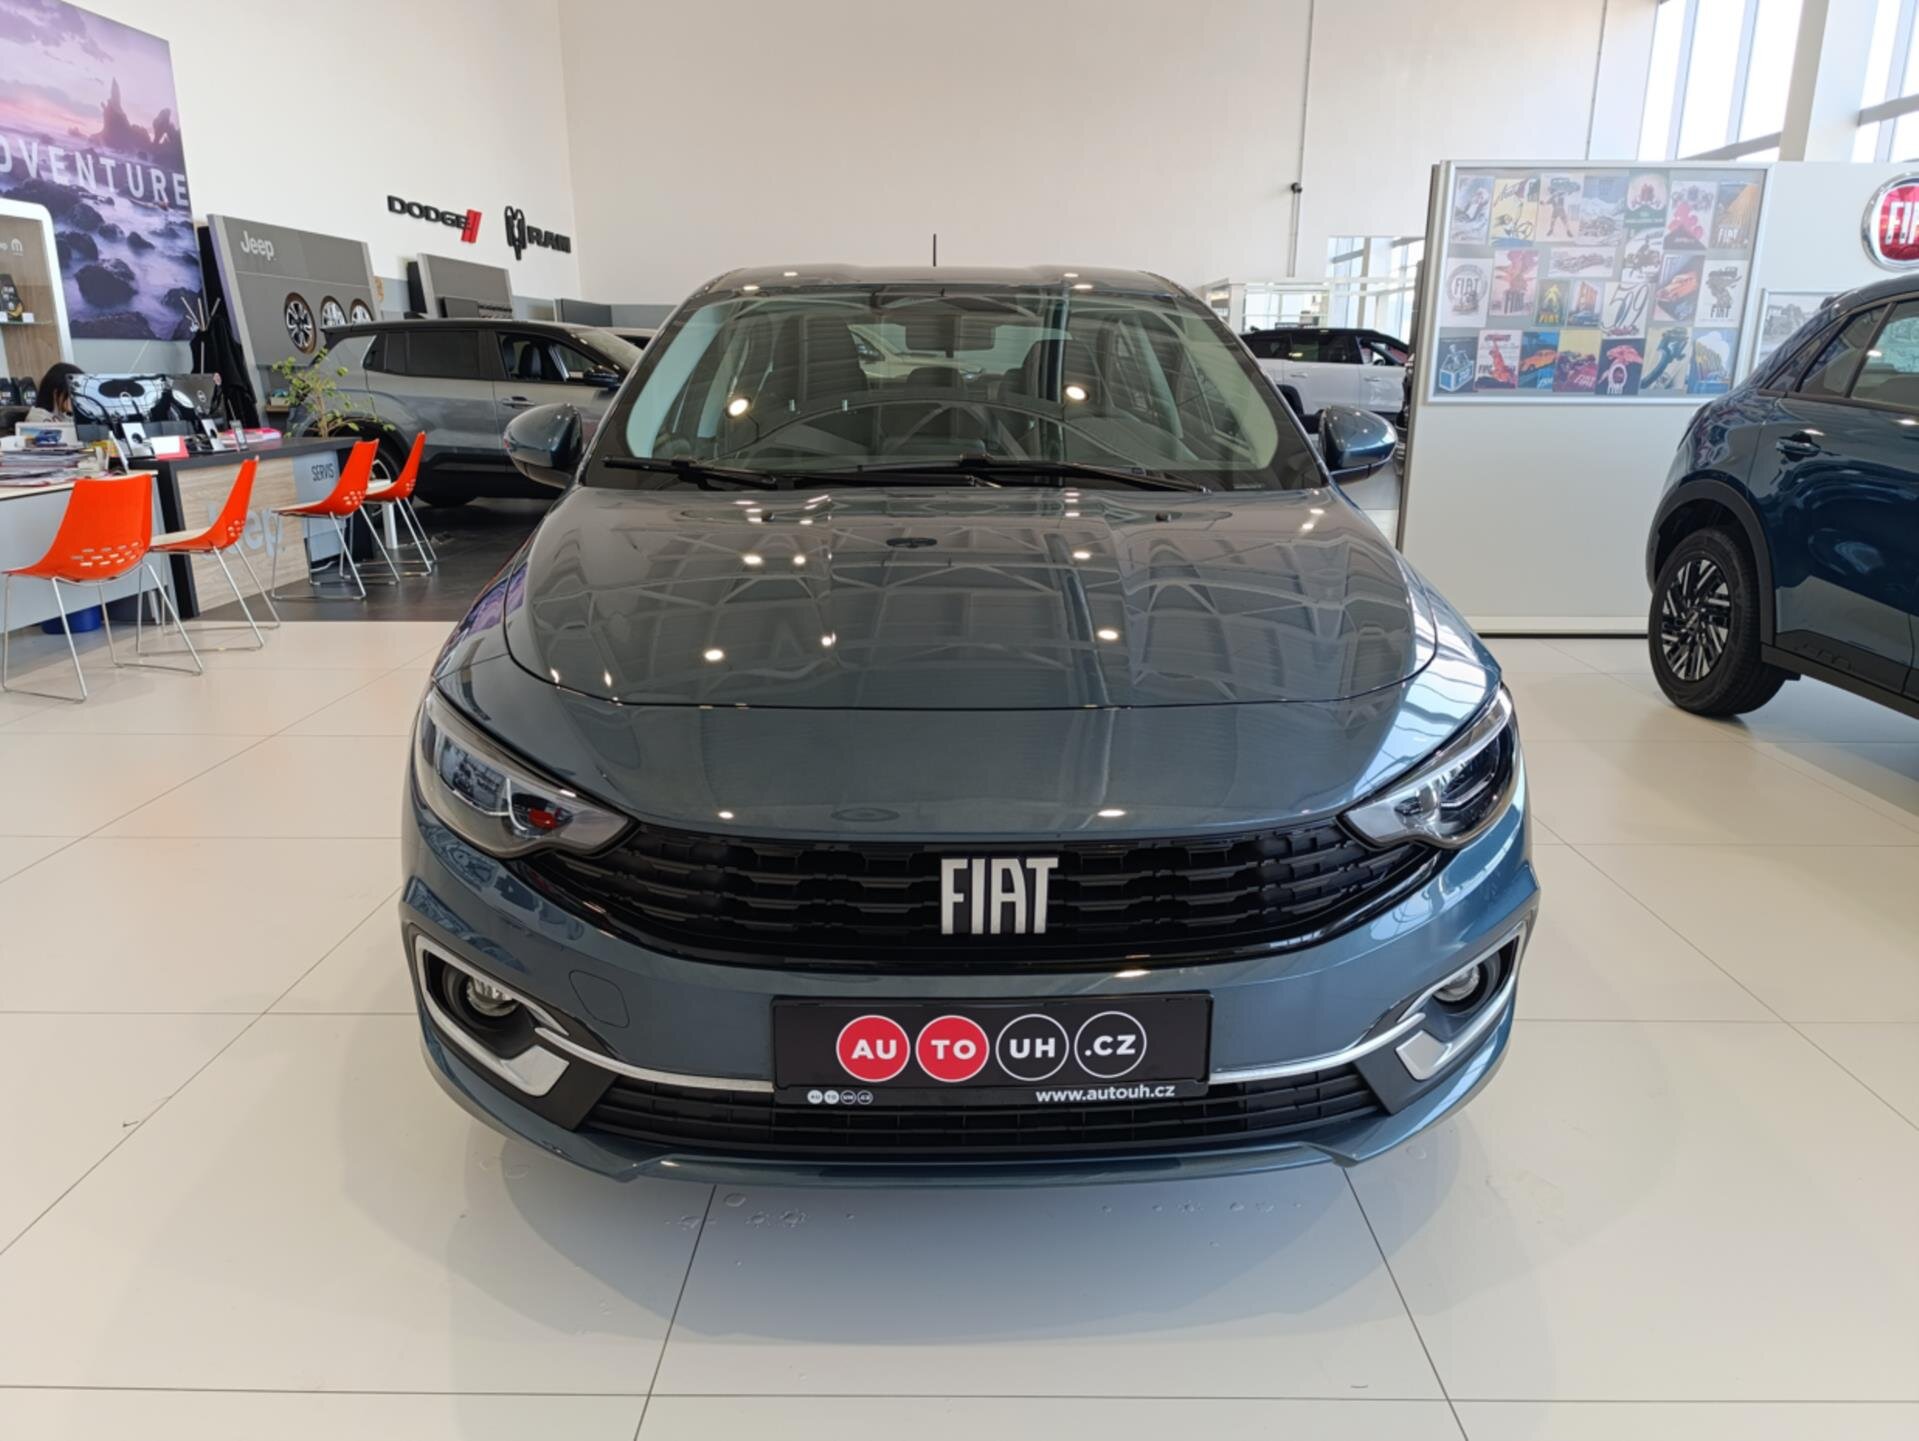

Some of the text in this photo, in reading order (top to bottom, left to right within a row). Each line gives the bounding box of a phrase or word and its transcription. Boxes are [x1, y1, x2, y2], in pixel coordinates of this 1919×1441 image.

[387, 195, 470, 231] DODGE
[240, 230, 275, 261] Jeep
[527, 225, 572, 254] RAM
[1454, 277, 1480, 297] FIAT
[311, 463, 335, 482] SERVIS
[940, 856, 1060, 935] FIAT
[1036, 1084, 1176, 1102] www.autouh.cz
